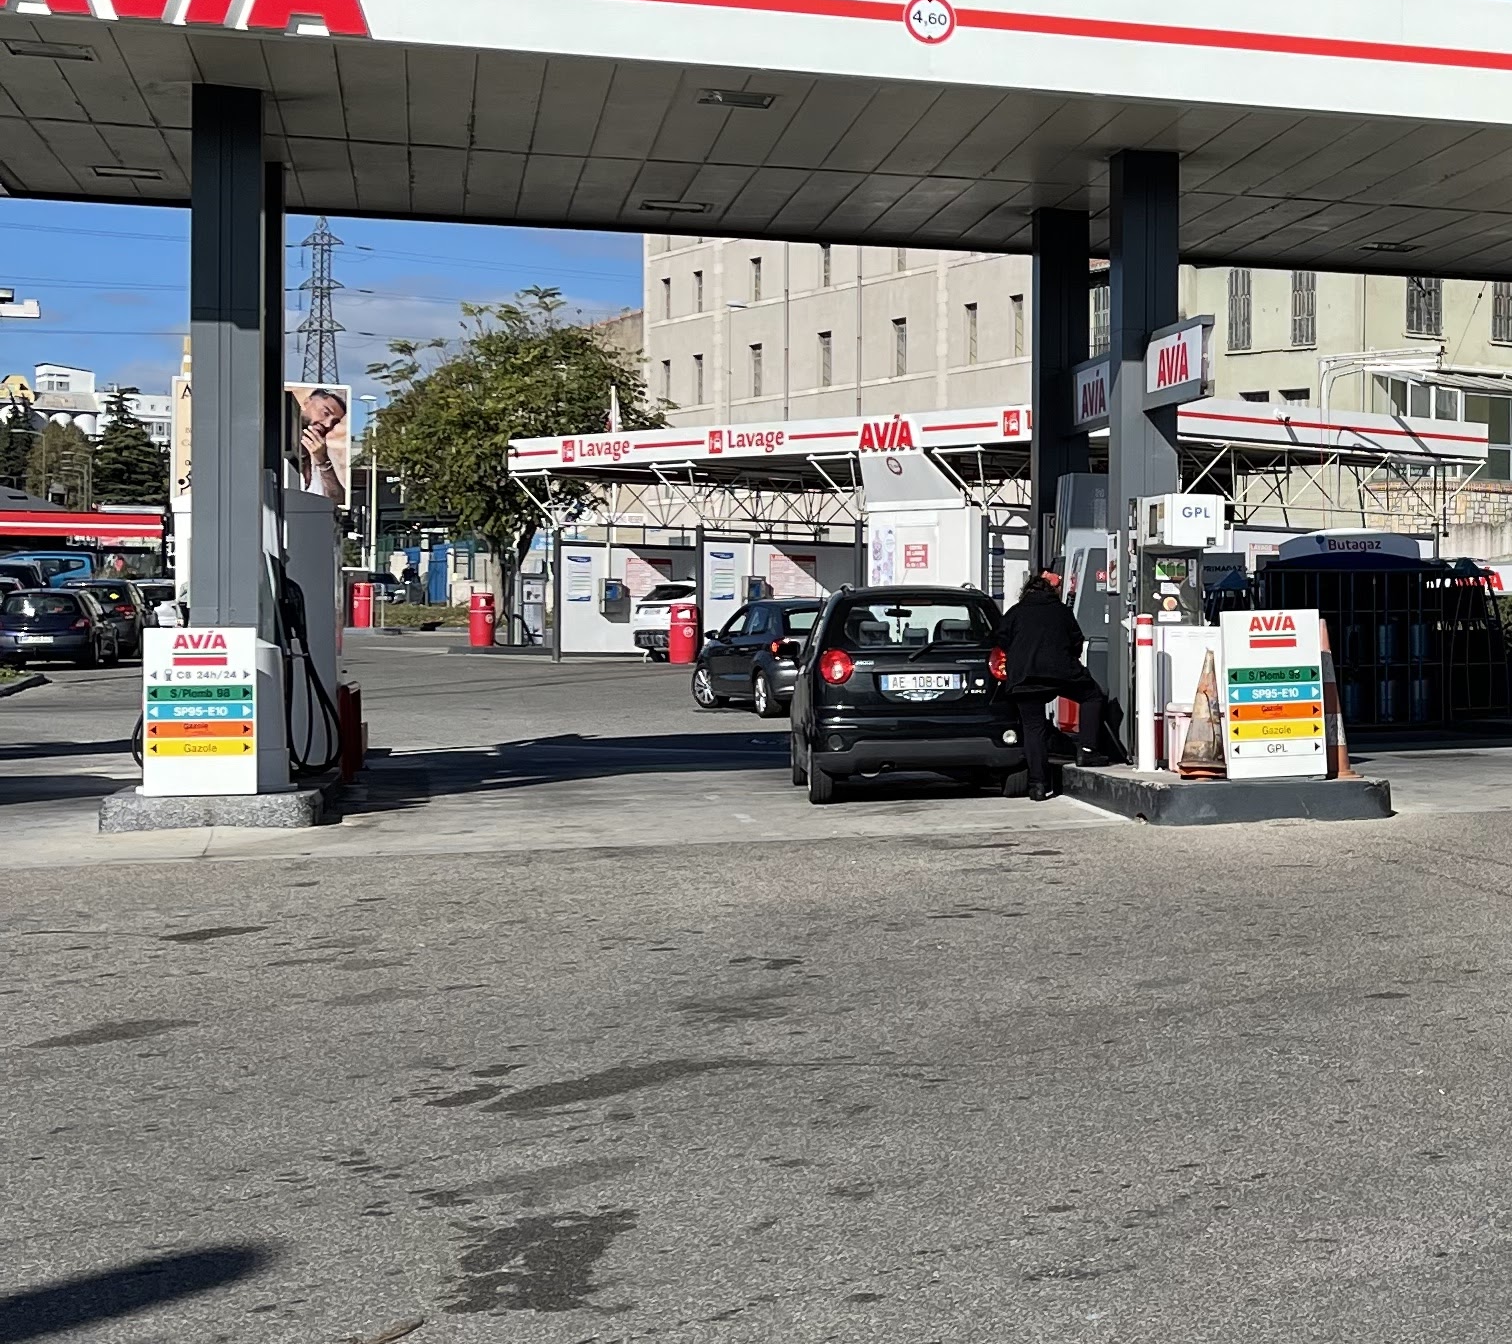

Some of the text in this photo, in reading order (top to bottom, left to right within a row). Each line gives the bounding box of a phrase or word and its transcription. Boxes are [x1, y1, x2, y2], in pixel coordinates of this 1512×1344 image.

[912, 9, 948, 27] 4,60
[727, 430, 784, 453] Lavage
[579, 439, 630, 461] Lavage
[1182, 506, 1211, 518] GPL
[1328, 538, 1382, 553] Butagaz
[1248, 670, 1286, 681] S/Plomb
[169, 687, 231, 699] S/Plomb 98
[1251, 687, 1300, 699] SP95-E10
[172, 705, 229, 717] SP95-E10
[1262, 725, 1292, 735] Gazole
[183, 743, 218, 753] Gazole
[1267, 744, 1289, 754] GPL
